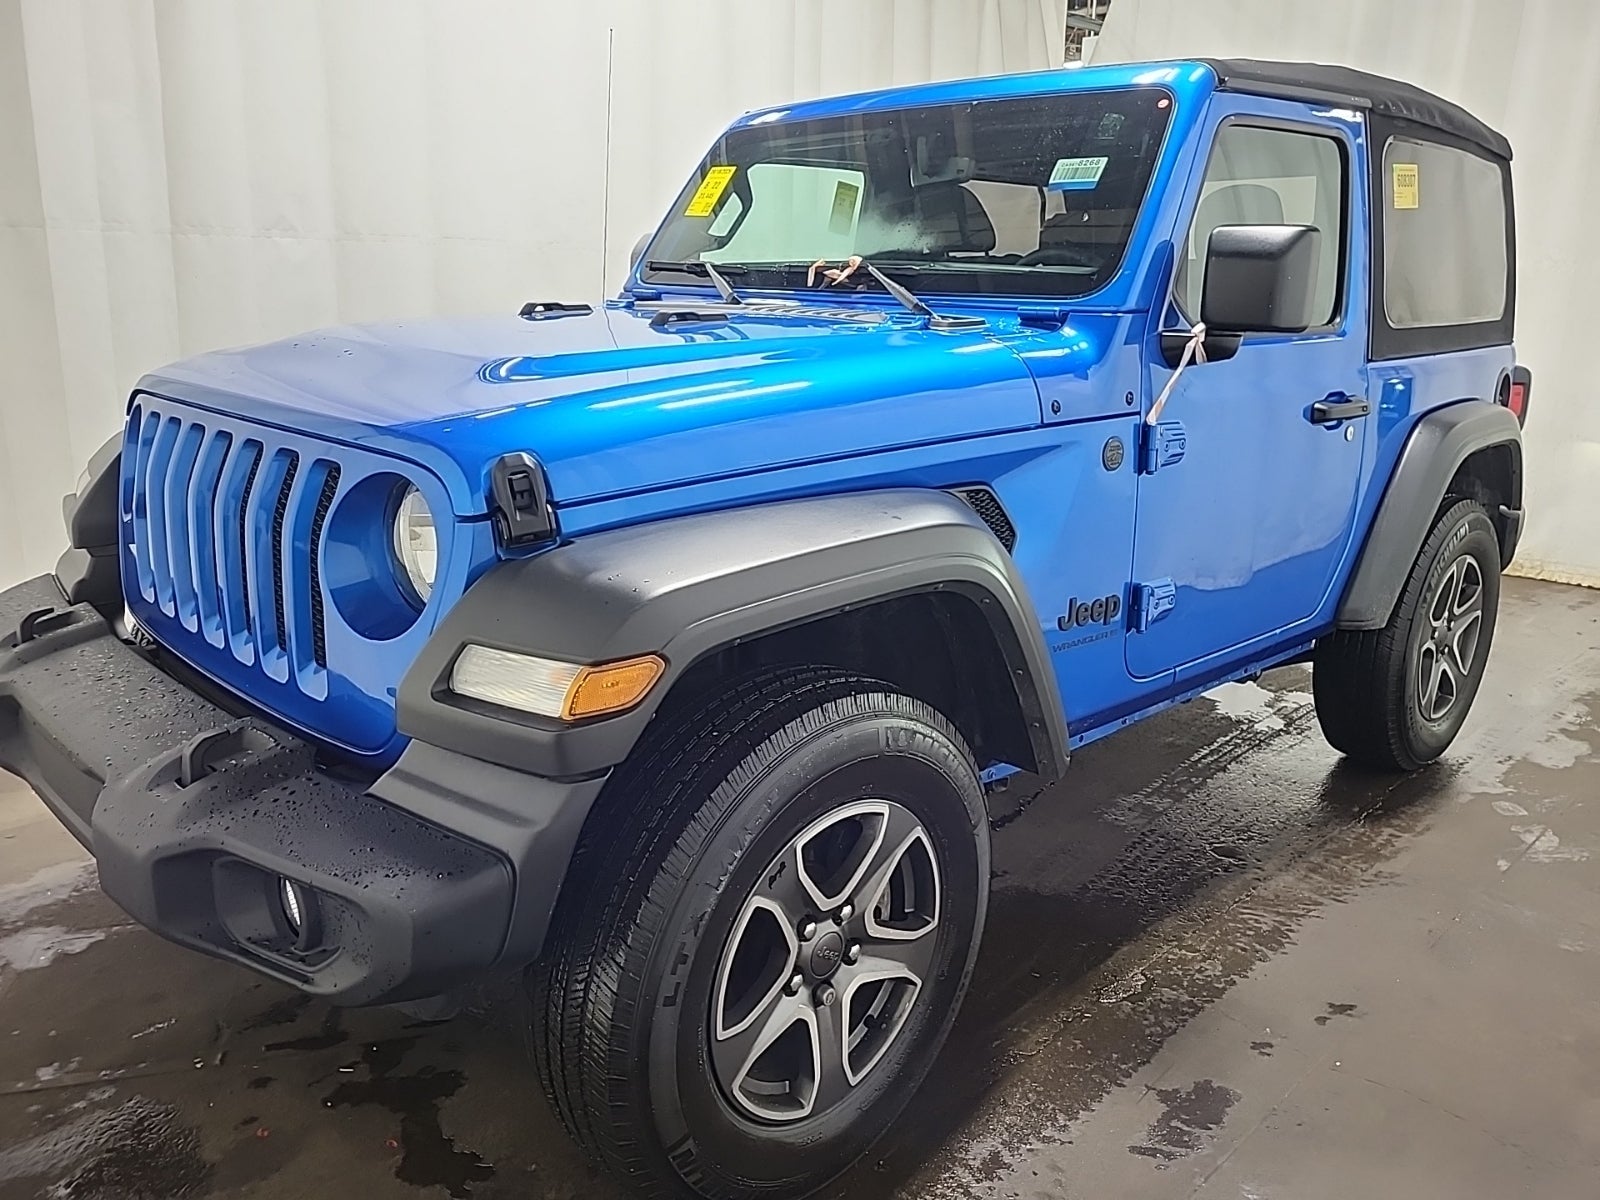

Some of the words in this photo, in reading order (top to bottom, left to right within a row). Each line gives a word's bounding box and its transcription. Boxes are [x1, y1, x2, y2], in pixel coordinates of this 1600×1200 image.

[1057, 594, 1121, 632] Jeep
[1052, 631, 1109, 653] WRANGLER
[816, 945, 840, 961] Jeep
